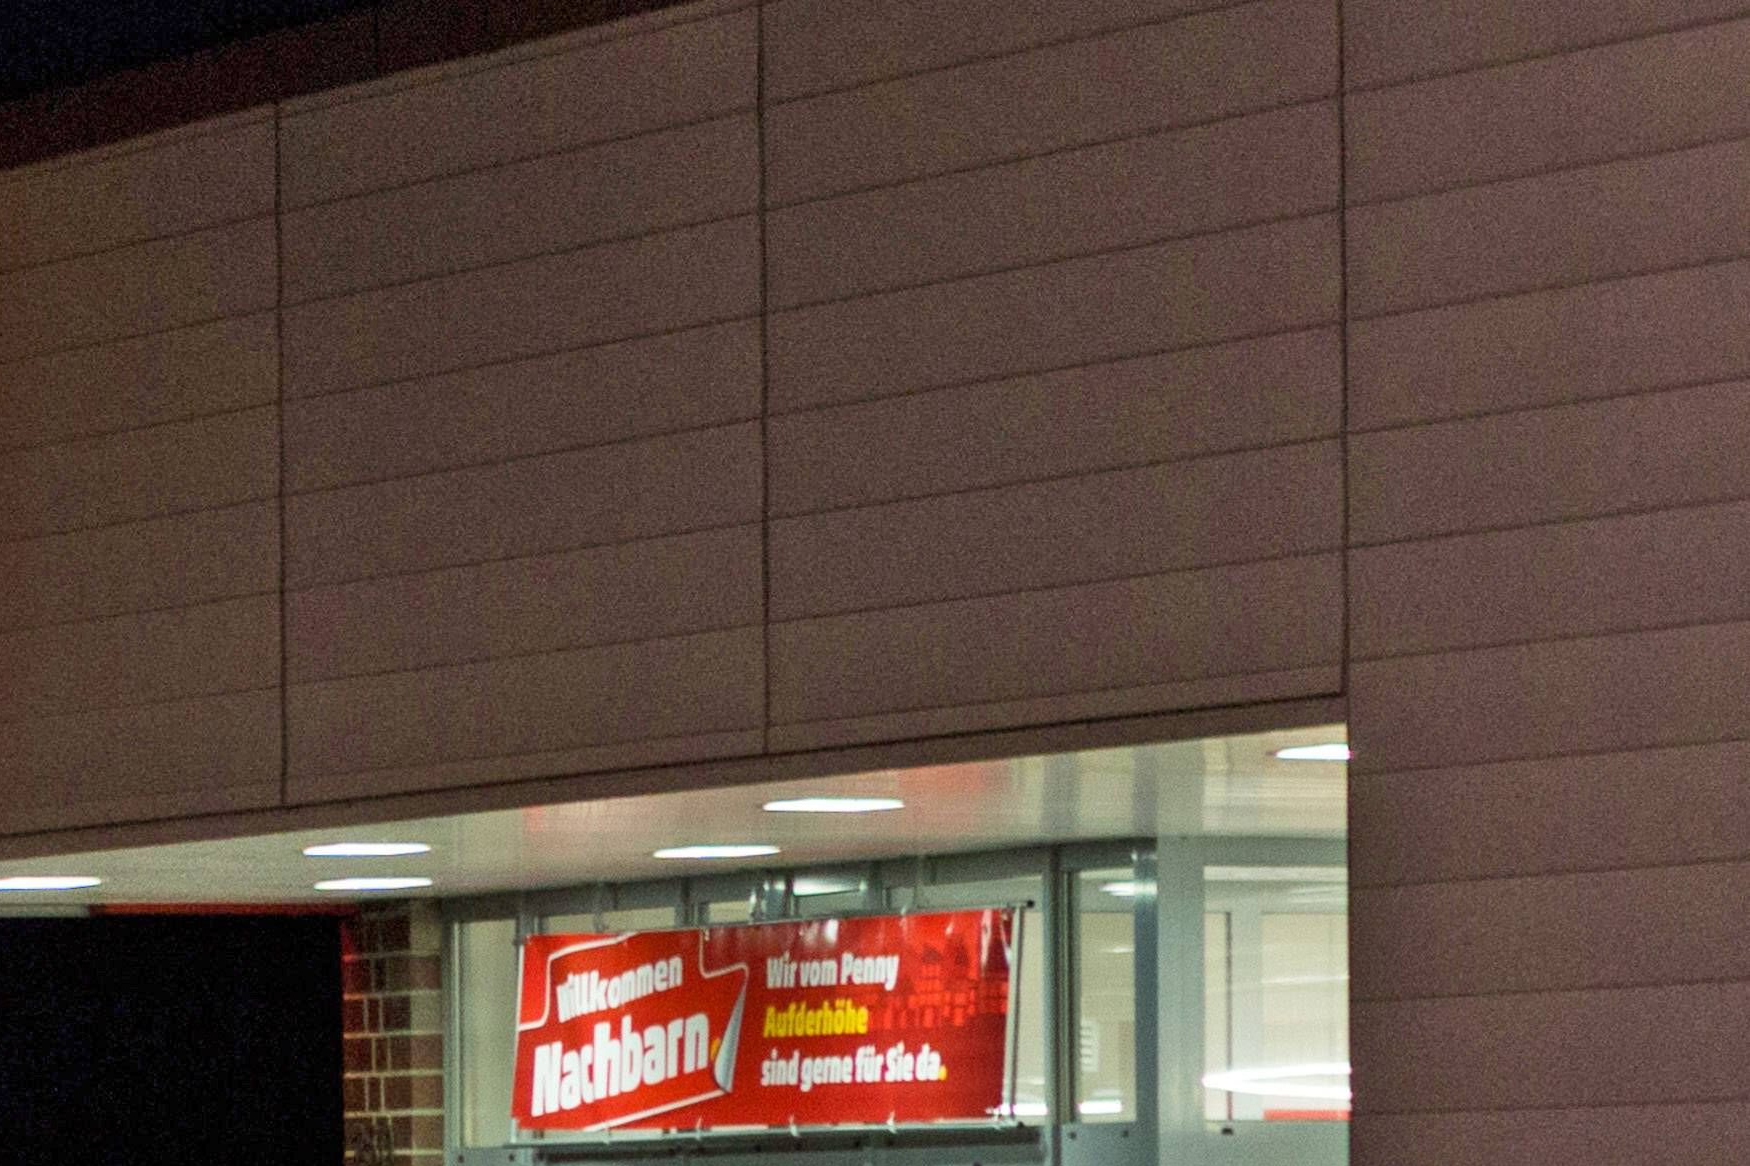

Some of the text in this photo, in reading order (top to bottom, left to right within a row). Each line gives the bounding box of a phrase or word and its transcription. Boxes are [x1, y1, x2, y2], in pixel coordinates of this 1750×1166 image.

[766, 950, 900, 991] Wir vom Penny
[763, 998, 869, 1038] Aufderhöhe
[760, 1048, 799, 1086] sind
[801, 1056, 854, 1093] gerne
[855, 1044, 884, 1083] für
[884, 1040, 915, 1082] Sie
